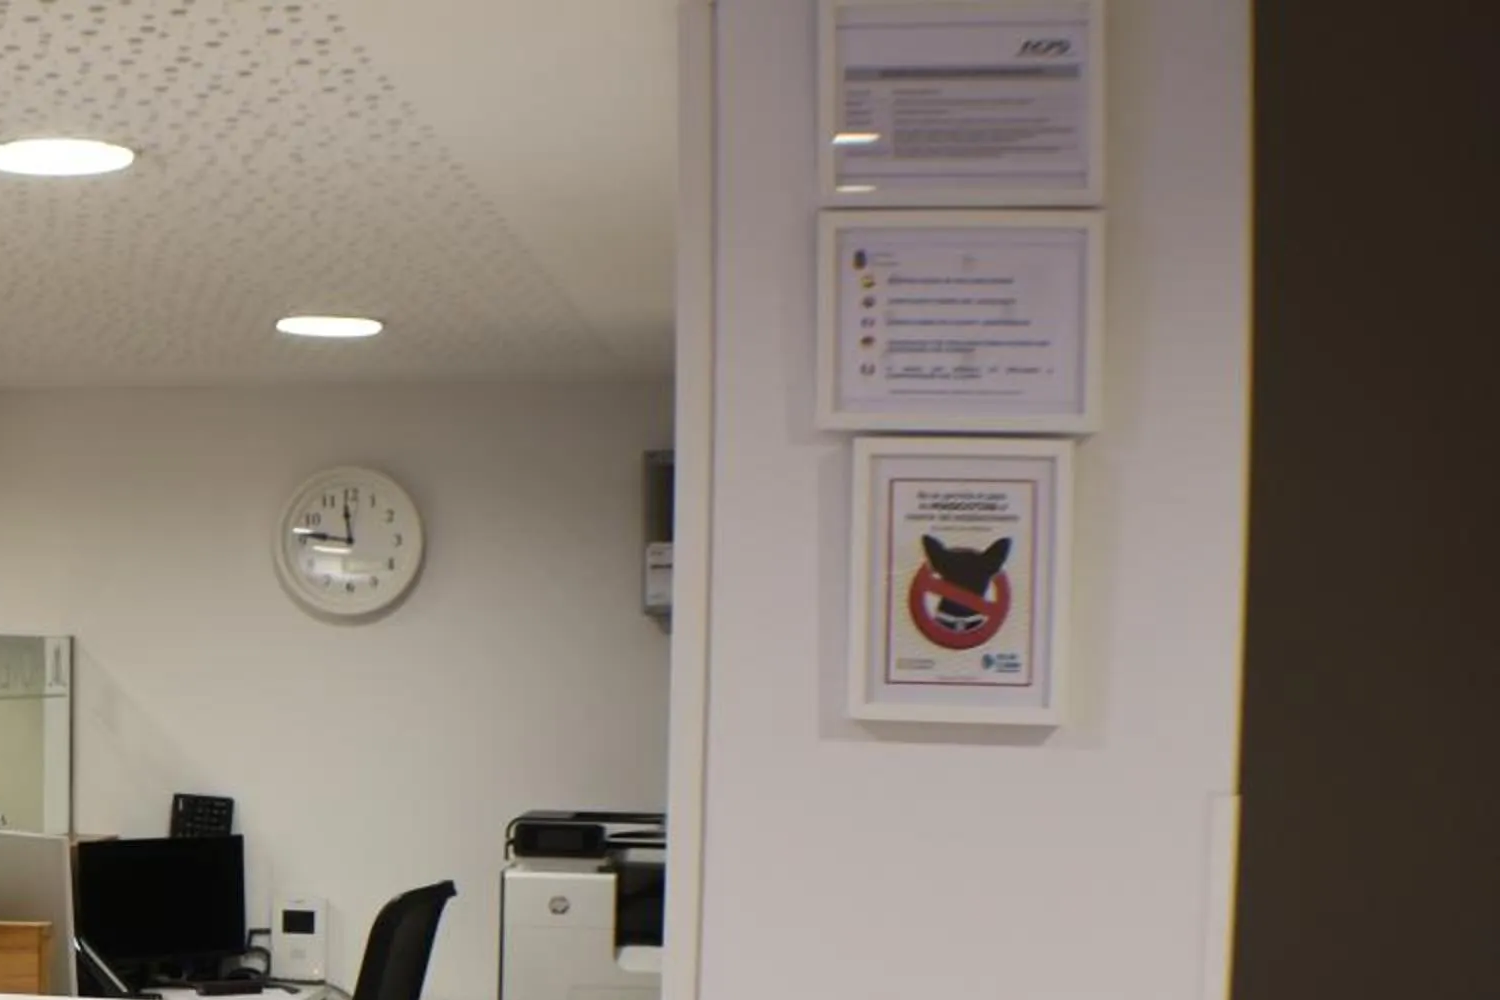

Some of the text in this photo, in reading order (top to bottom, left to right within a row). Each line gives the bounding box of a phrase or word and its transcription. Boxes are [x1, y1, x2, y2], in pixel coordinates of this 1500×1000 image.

[322, 494, 336, 508] 11
[370, 494, 376, 508] 1
[305, 512, 321, 526] 10
[385, 508, 395, 523] 2
